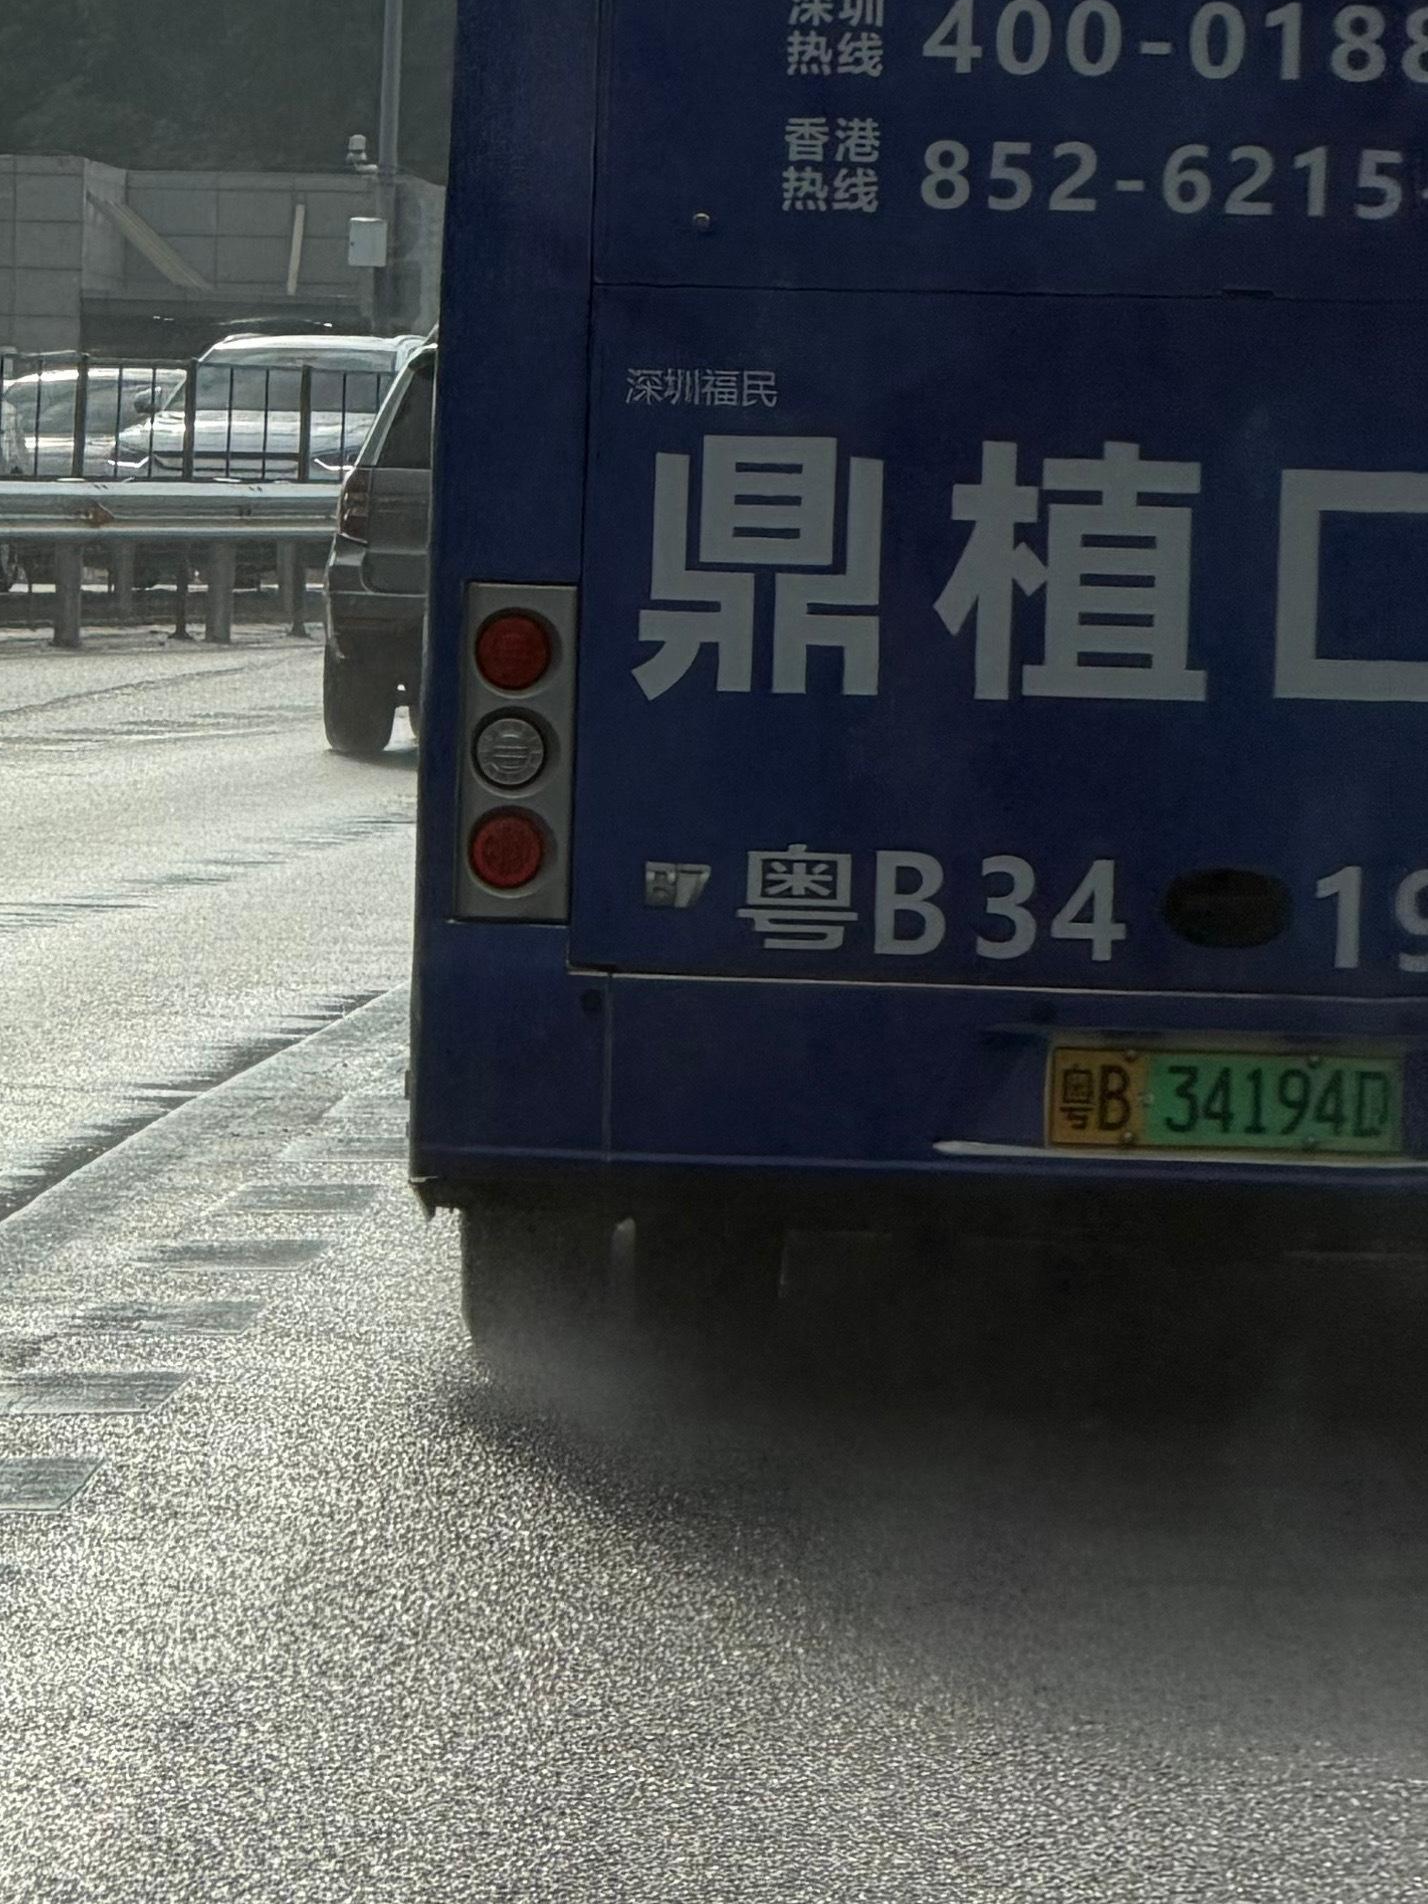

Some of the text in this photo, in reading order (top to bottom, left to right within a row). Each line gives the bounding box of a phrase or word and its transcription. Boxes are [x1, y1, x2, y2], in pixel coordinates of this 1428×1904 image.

[786, 29, 884, 78] 热线
[784, 117, 881, 163] 香港
[781, 165, 879, 213] 热线
[920, 139, 1428, 220] 852-6215
[626, 367, 778, 408] 深圳福民
